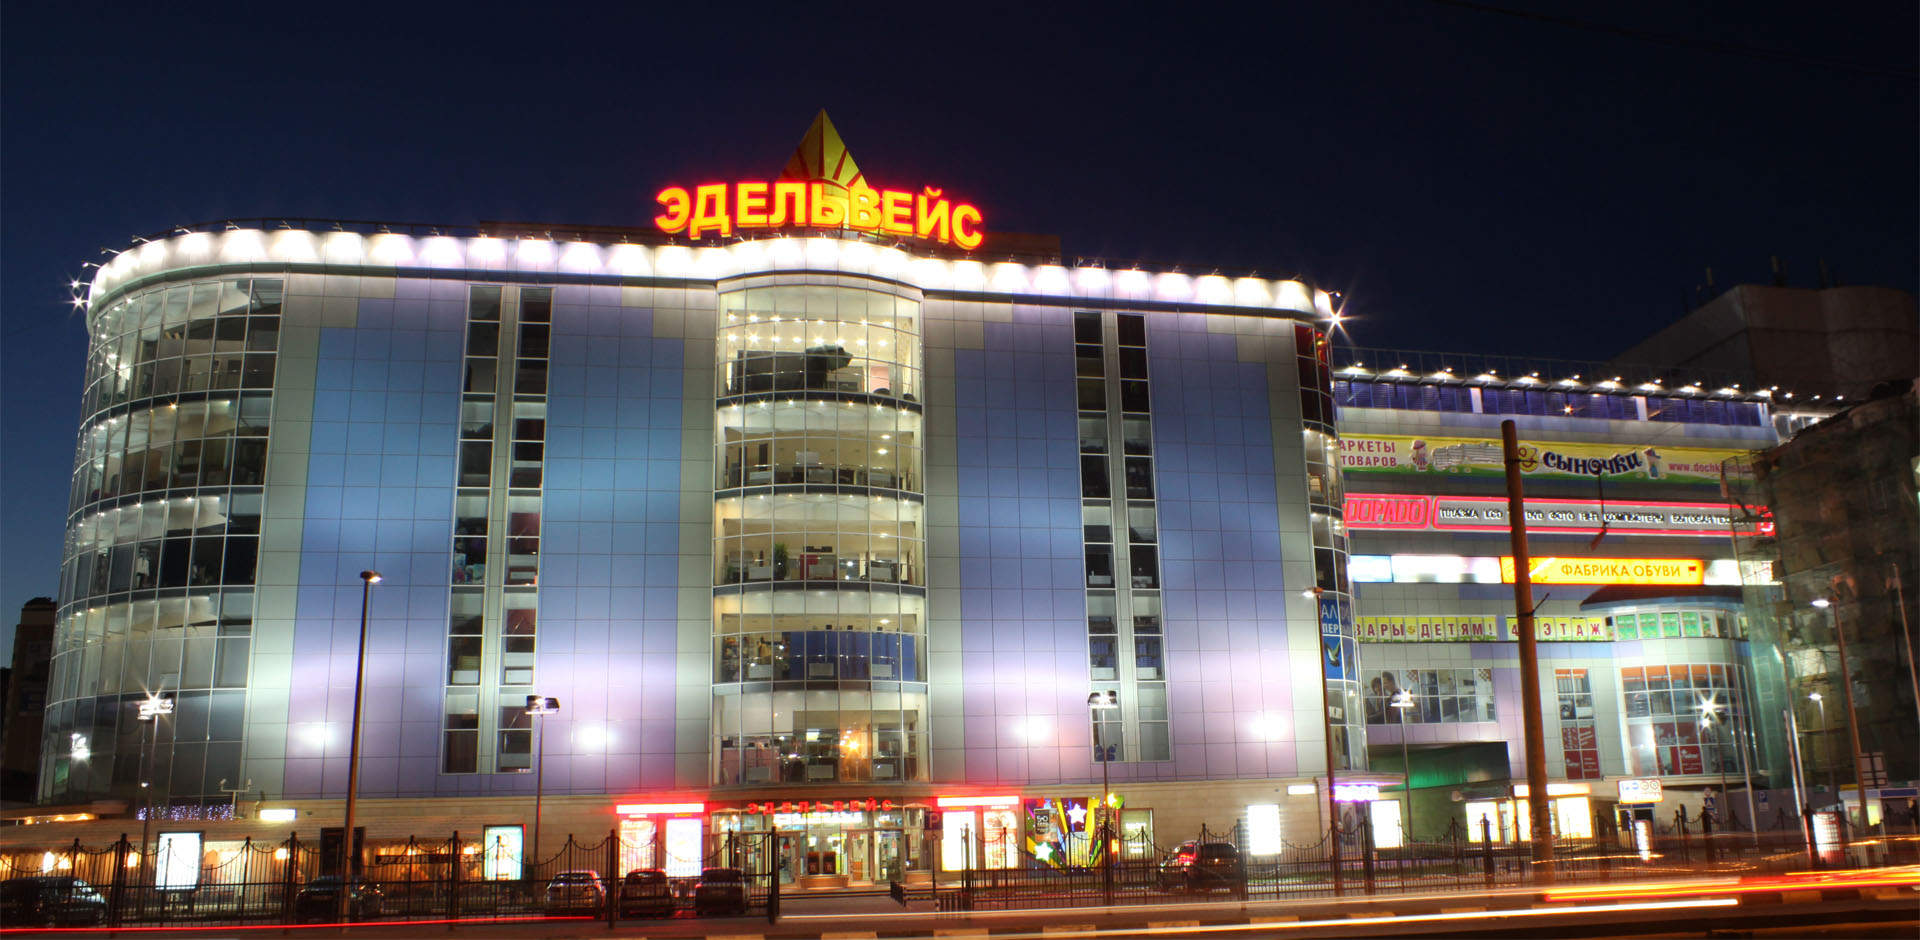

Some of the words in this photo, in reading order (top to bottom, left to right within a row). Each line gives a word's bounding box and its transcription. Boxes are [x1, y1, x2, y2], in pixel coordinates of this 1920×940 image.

[654, 182, 983, 250] ЭДЕЛЬВЕЙС
[1341, 455, 1397, 467] ТОВАРОВ
[1561, 563, 1629, 577] ФАБРИКА
[1633, 565, 1681, 578] ОБУВИ
[1421, 623, 1493, 638] ДЕТЯМ!
[1543, 622, 1601, 637] ЭТАЖ
[747, 797, 893, 816] ЭДЕЛЬВЕЙС
